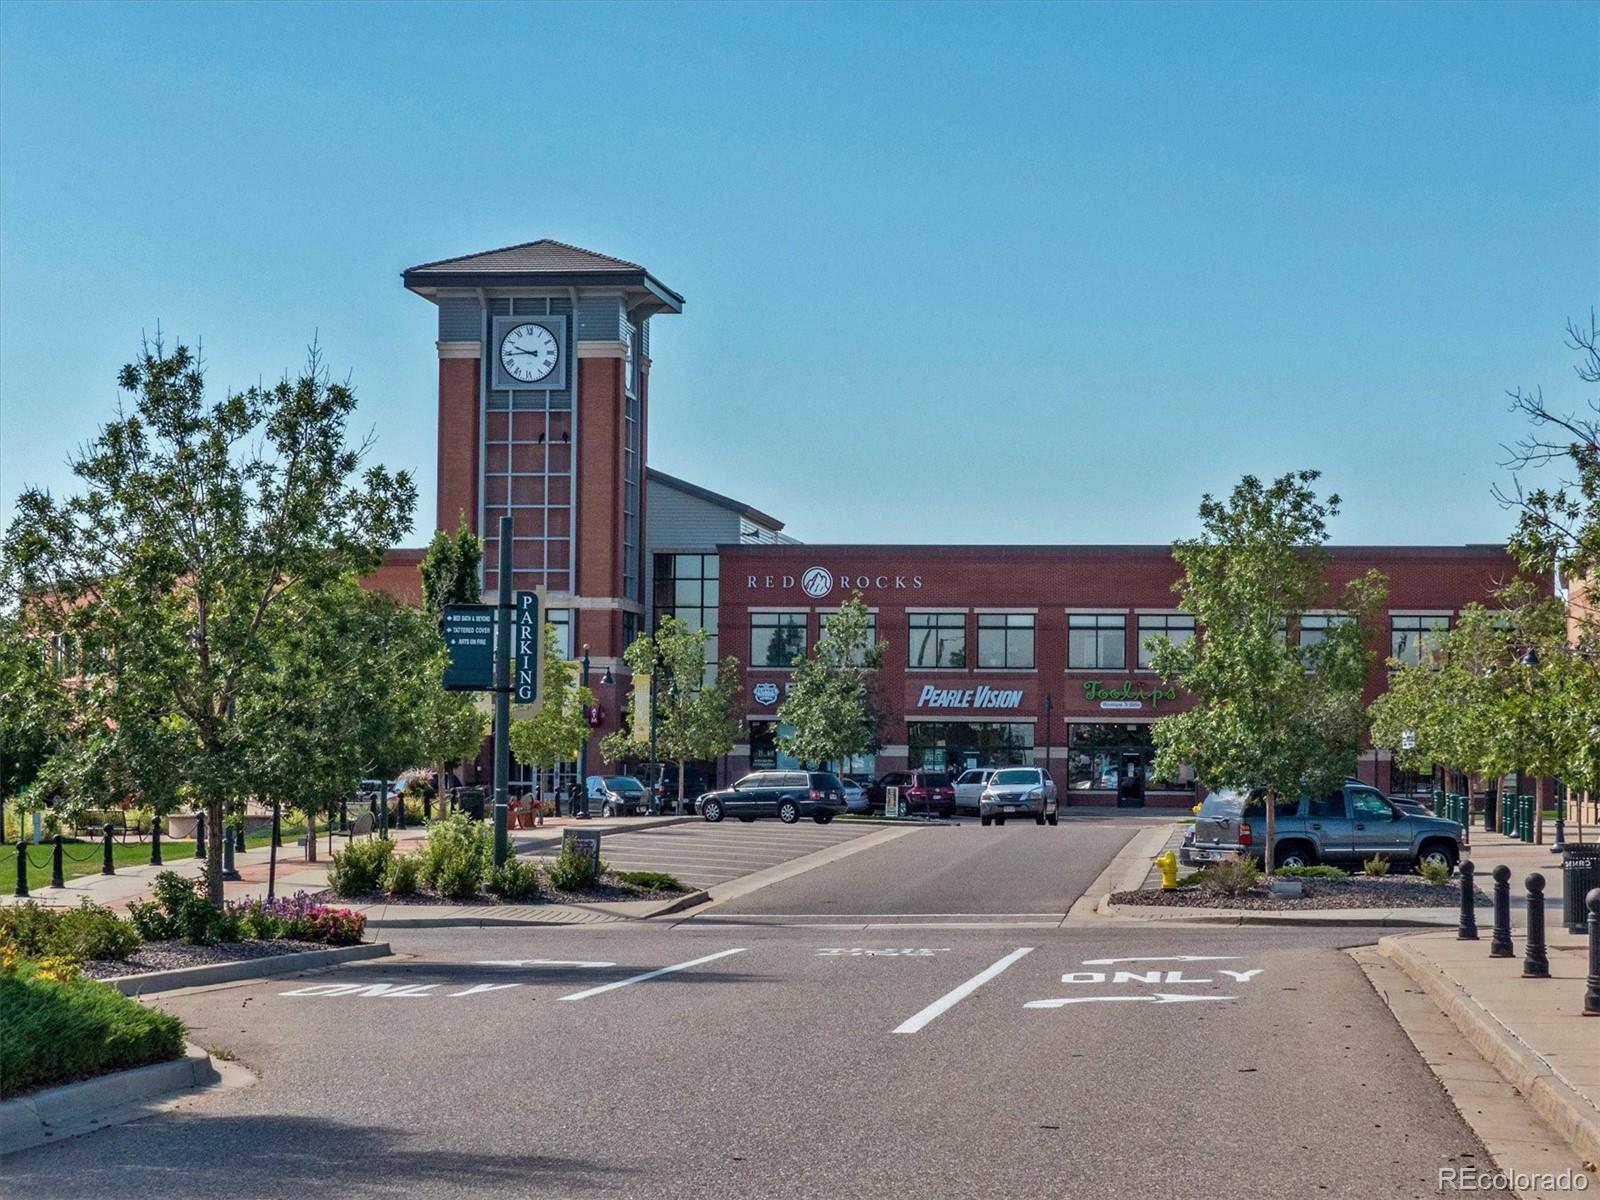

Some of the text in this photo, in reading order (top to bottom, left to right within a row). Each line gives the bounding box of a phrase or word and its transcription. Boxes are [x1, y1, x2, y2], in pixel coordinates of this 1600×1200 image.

[747, 575, 923, 589] RED ROCKS
[519, 596, 533, 699] PARKING
[917, 685, 1023, 708] PEARLE VISION
[1061, 969, 1265, 983] ONLY
[279, 984, 524, 997] ONLY
